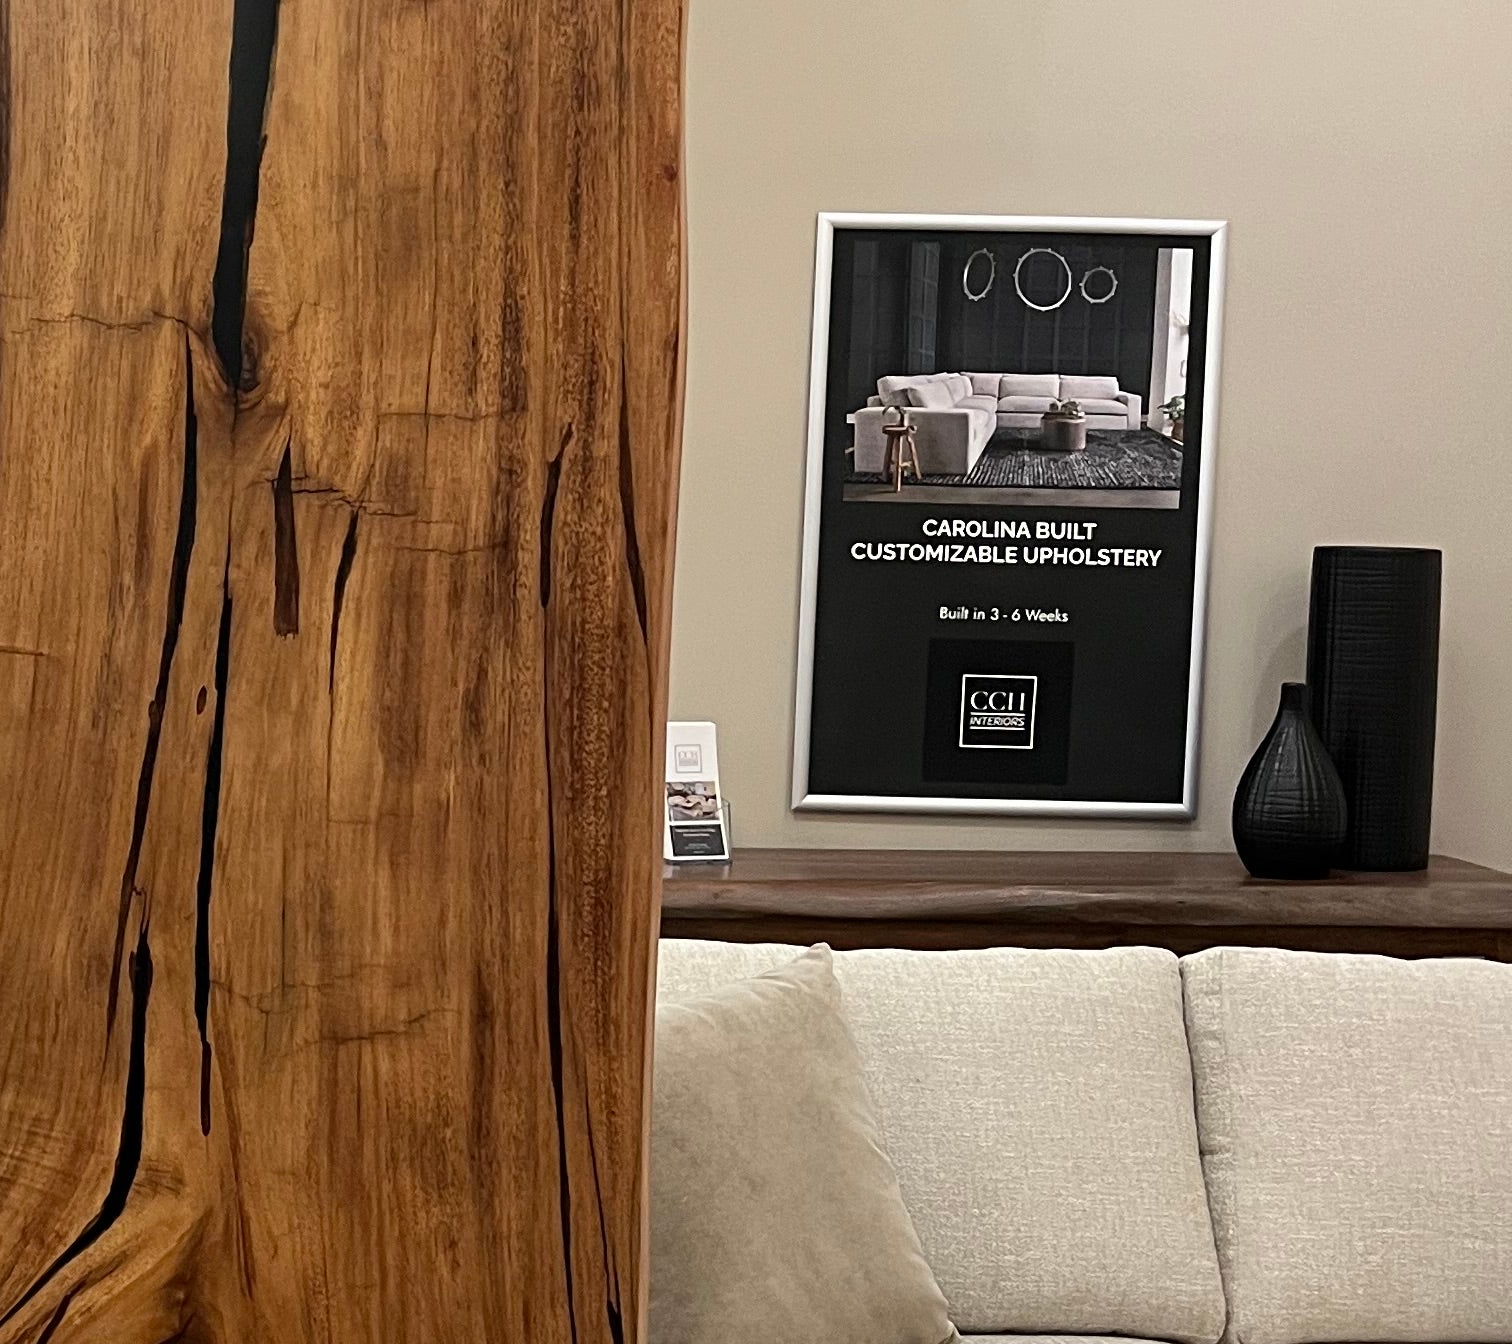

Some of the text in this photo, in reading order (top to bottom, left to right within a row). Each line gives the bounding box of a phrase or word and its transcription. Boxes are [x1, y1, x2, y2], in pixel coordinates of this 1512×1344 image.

[922, 519, 1097, 540] CAROLINA BUILT
[851, 543, 1162, 567] CUSTOMIZABLE UPHOLSTERY
[939, 606, 969, 620] Built
[973, 607, 986, 620] in
[990, 607, 999, 621] 3
[1011, 608, 1021, 621] 6
[1025, 608, 1069, 623] Weeks
[969, 716, 1025, 727] INTERIORS
